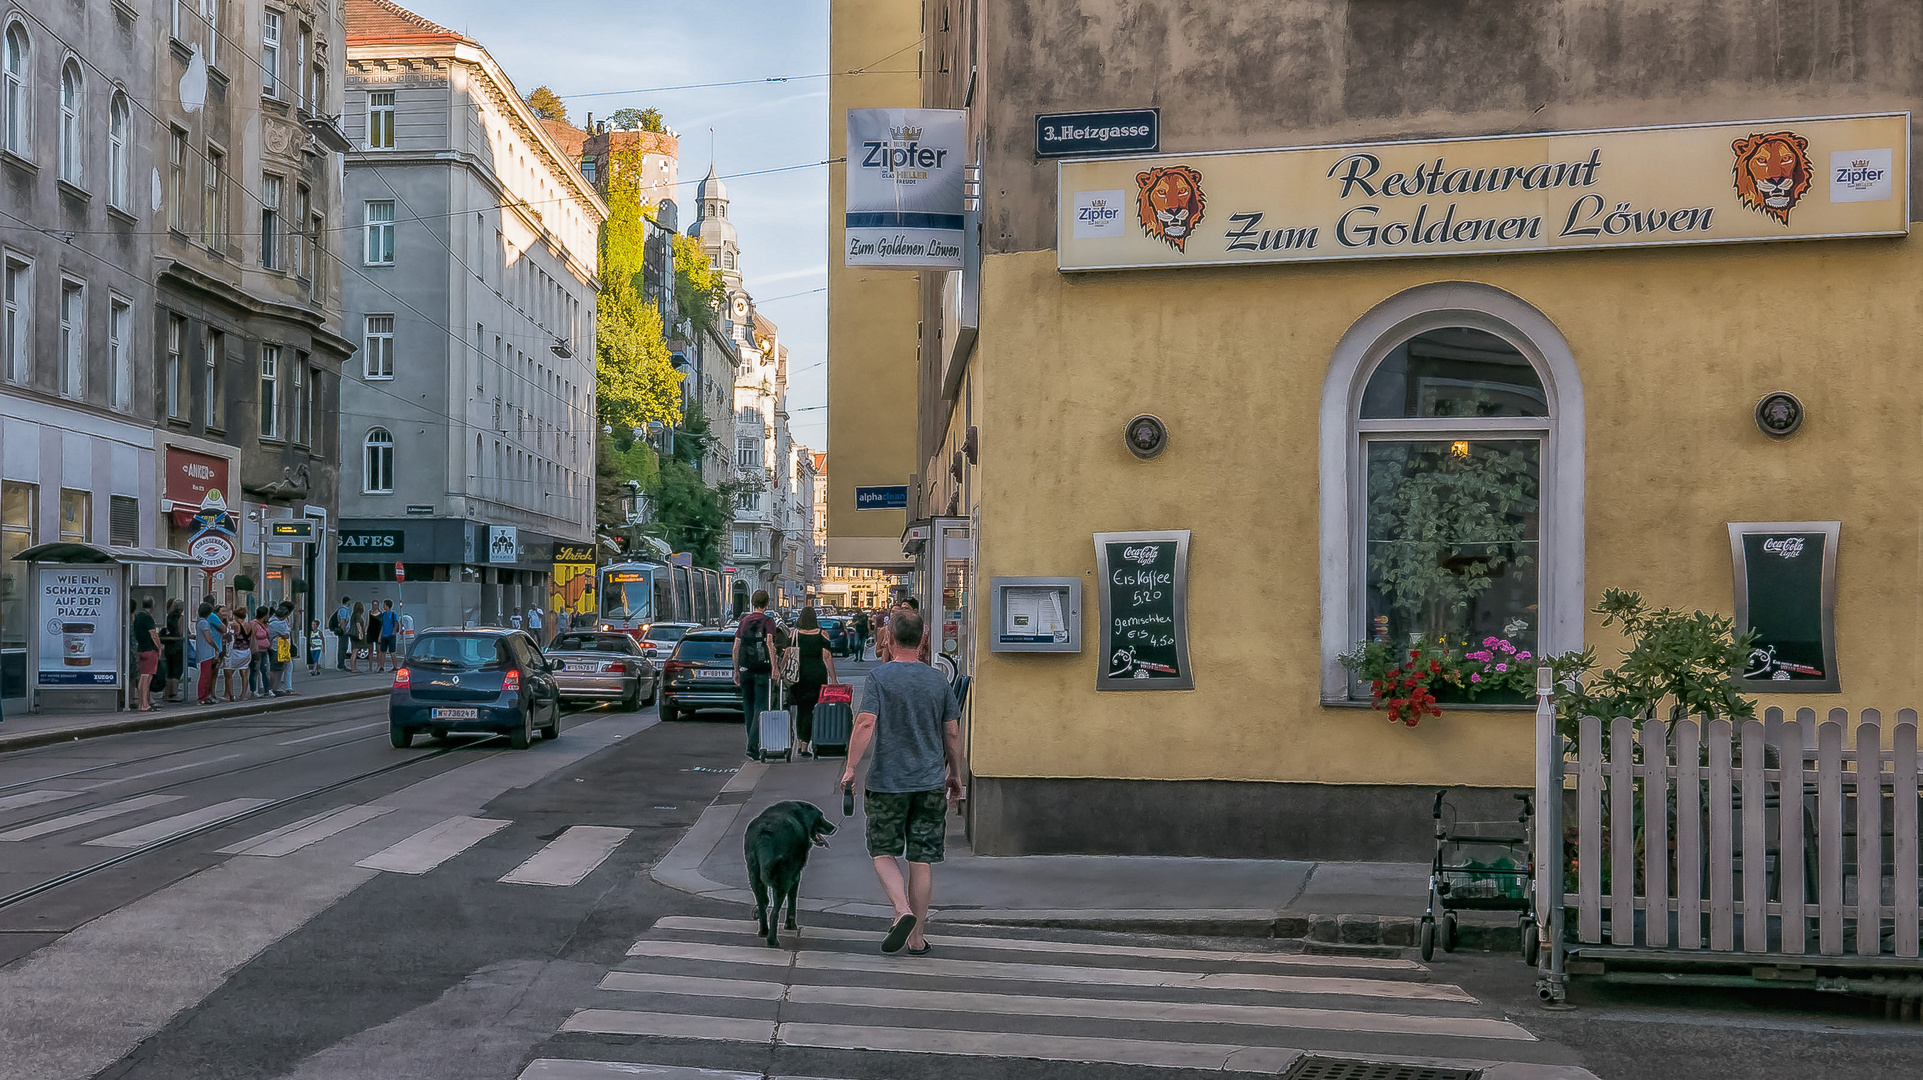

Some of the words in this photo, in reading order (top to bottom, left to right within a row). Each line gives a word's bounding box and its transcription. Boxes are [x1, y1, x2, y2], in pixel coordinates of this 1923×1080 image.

[862, 142, 947, 173] Zipfer
[897, 171, 928, 179] HELLER
[1326, 147, 1602, 199] Restaurant
[1836, 168, 1885, 184] Zipfer
[1078, 207, 1119, 222] Zipfer
[1225, 211, 1320, 252] Zum
[1335, 202, 1542, 247] Goldenen
[1558, 194, 1715, 240] Löwen
[850, 237, 875, 256] Zum
[878, 234, 925, 258] Goldenen
[927, 239, 960, 257] Löwen
[188, 463, 209, 480] ANKER
[859, 492, 906, 503] alphaclean
[195, 538, 229, 551] STRASSENBAHN
[1764, 537, 1805, 551] Coca-Cola
[556, 547, 593, 561] Ströck
[1123, 545, 1160, 559] Coca-Cola
[1780, 549, 1800, 559] light
[1137, 556, 1155, 566] light
[58, 576, 78, 584] WIE
[81, 576, 99, 584] EIN
[608, 573, 614, 583] 1
[45, 587, 111, 595] SCHMATZER
[80, 597, 101, 605] DER
[1132, 590, 1162, 606] 5.20
[58, 608, 101, 616] PIAZZA.
[1150, 634, 1175, 647] 4.50
